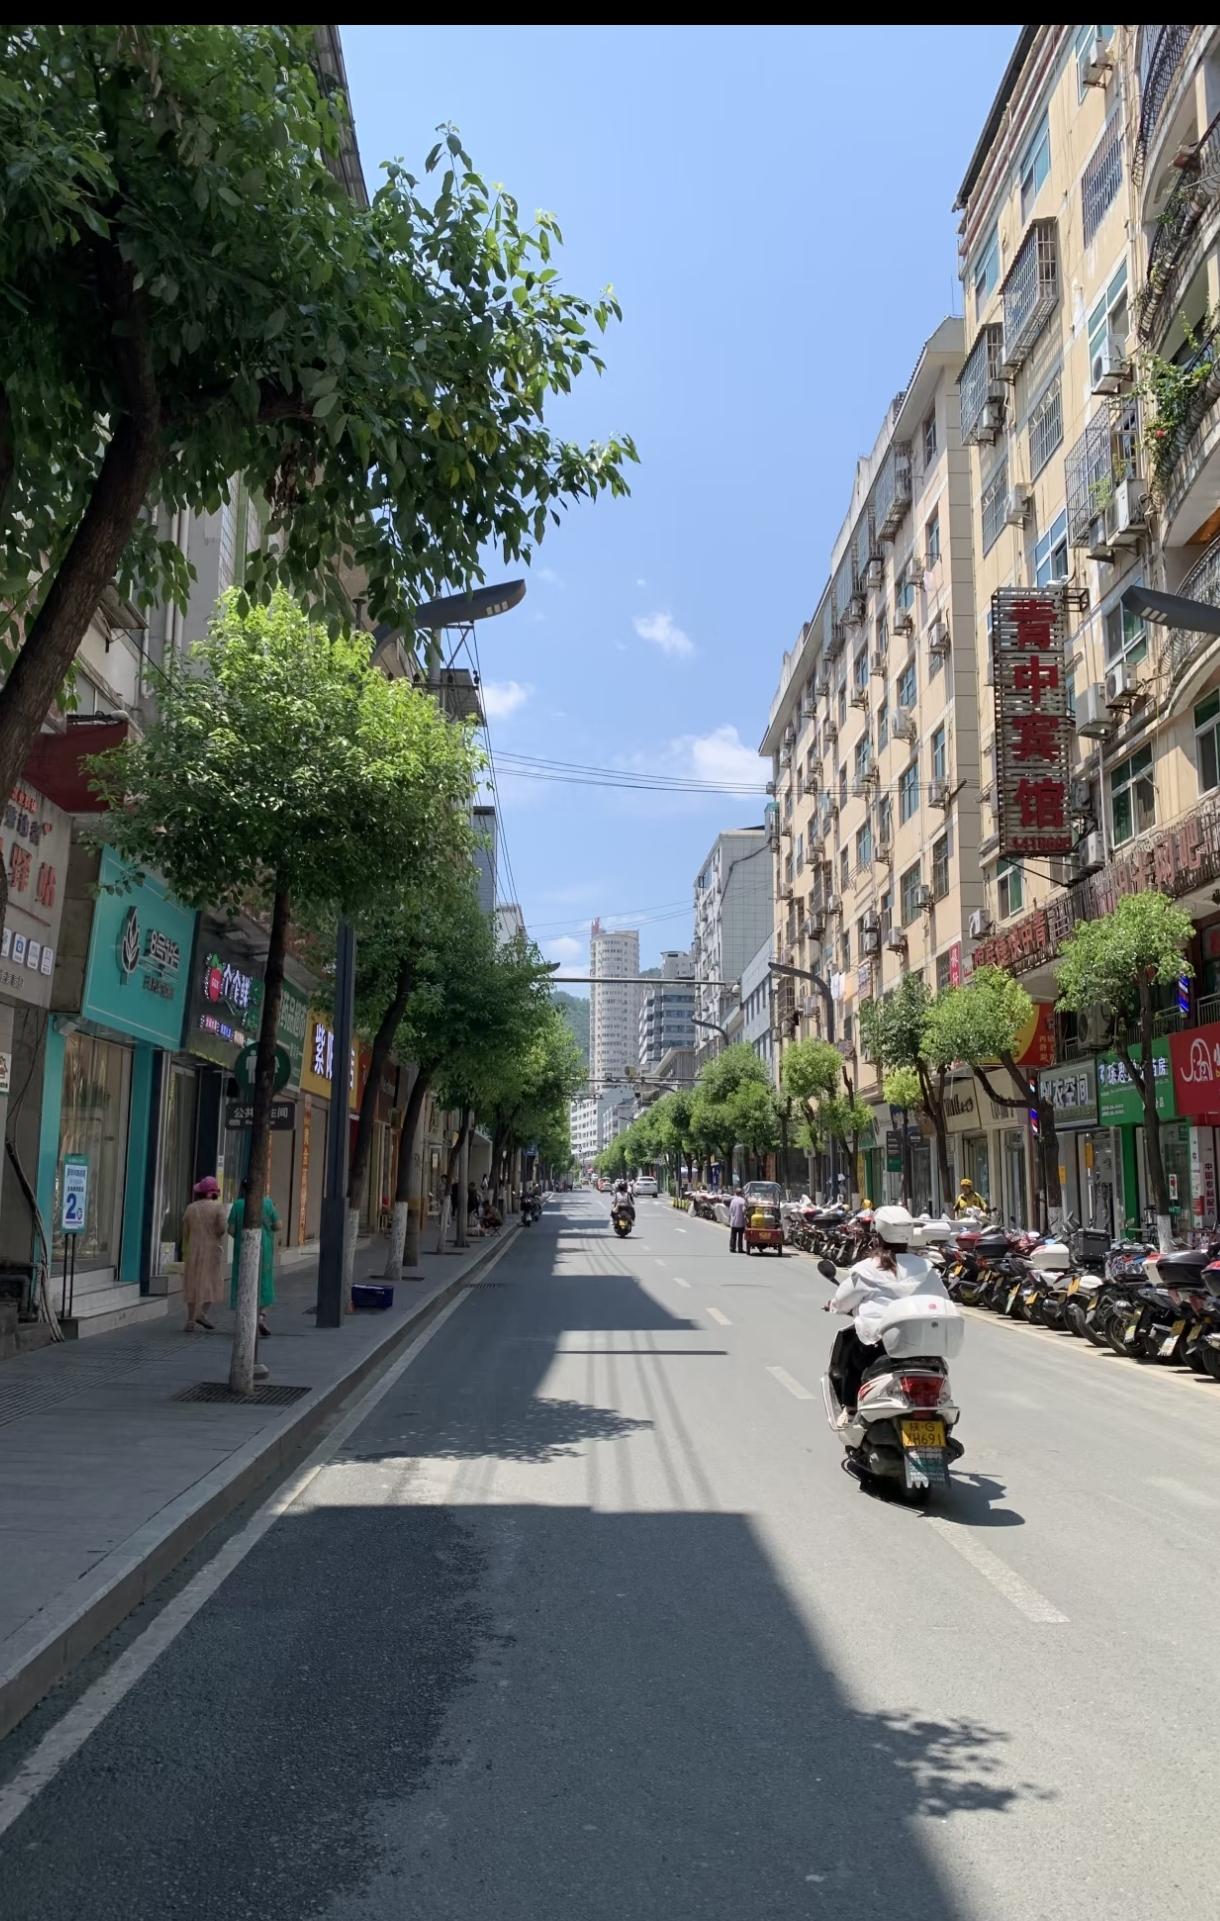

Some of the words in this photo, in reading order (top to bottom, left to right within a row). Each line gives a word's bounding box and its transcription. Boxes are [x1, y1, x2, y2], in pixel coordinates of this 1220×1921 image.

[1010, 600, 1066, 828] 青中宾馆
[233, 1107, 288, 1119] 公共生间
